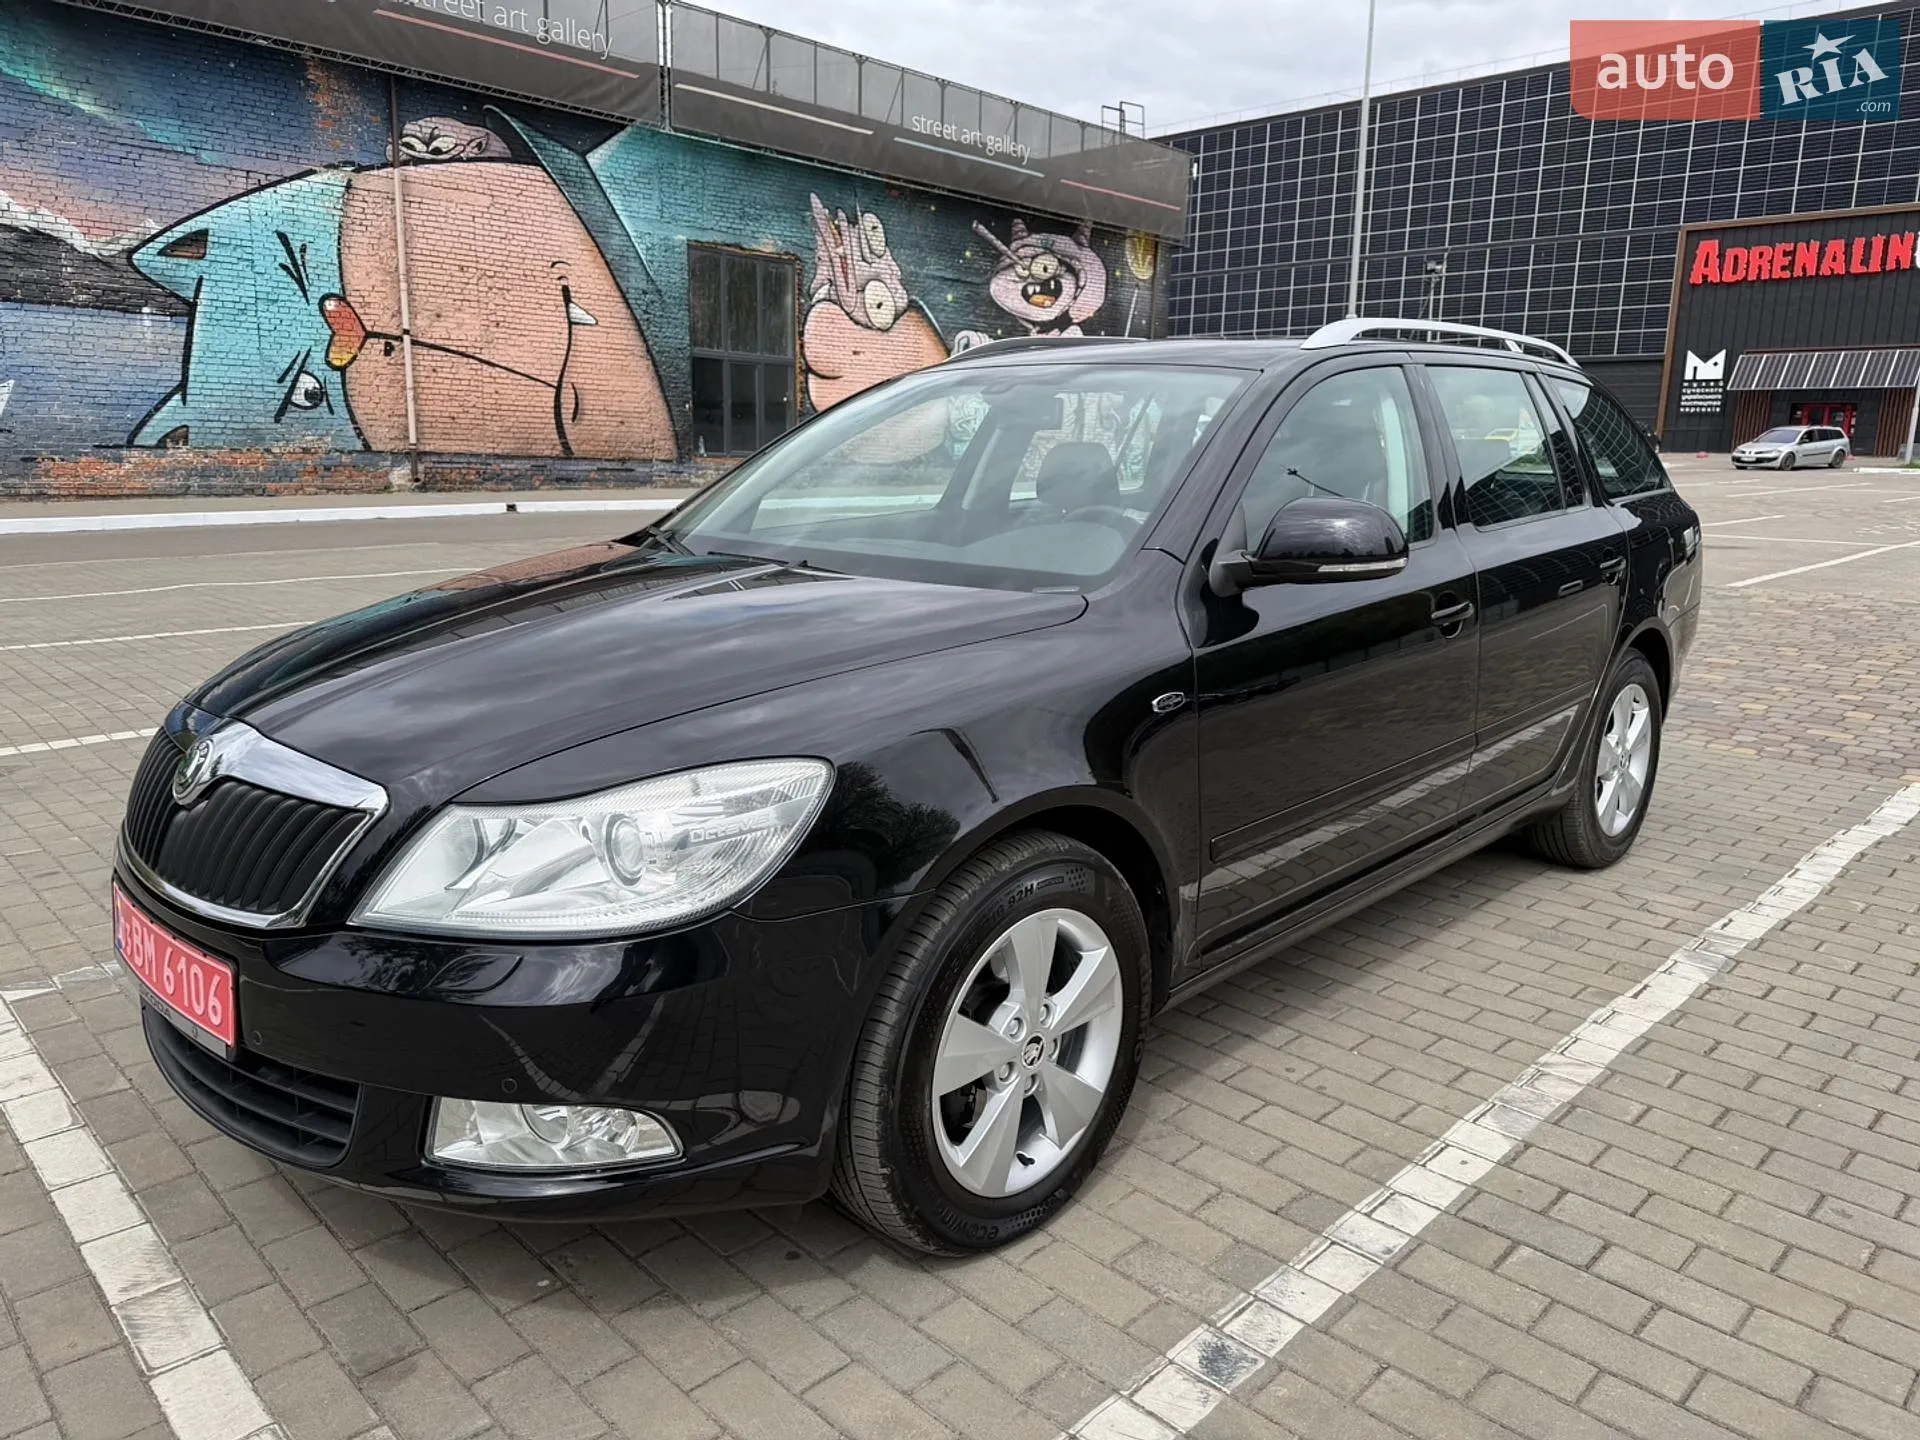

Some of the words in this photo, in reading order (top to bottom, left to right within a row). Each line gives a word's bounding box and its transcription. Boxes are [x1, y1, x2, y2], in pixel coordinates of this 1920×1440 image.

[494, 6, 528, 33] art
[536, 15, 613, 60] gallery
[911, 115, 957, 142] street
[961, 128, 982, 148] art
[986, 134, 1031, 165] gallery
[1688, 231, 1915, 286] ADRENALIN
[163, 946, 223, 1026] 6106
